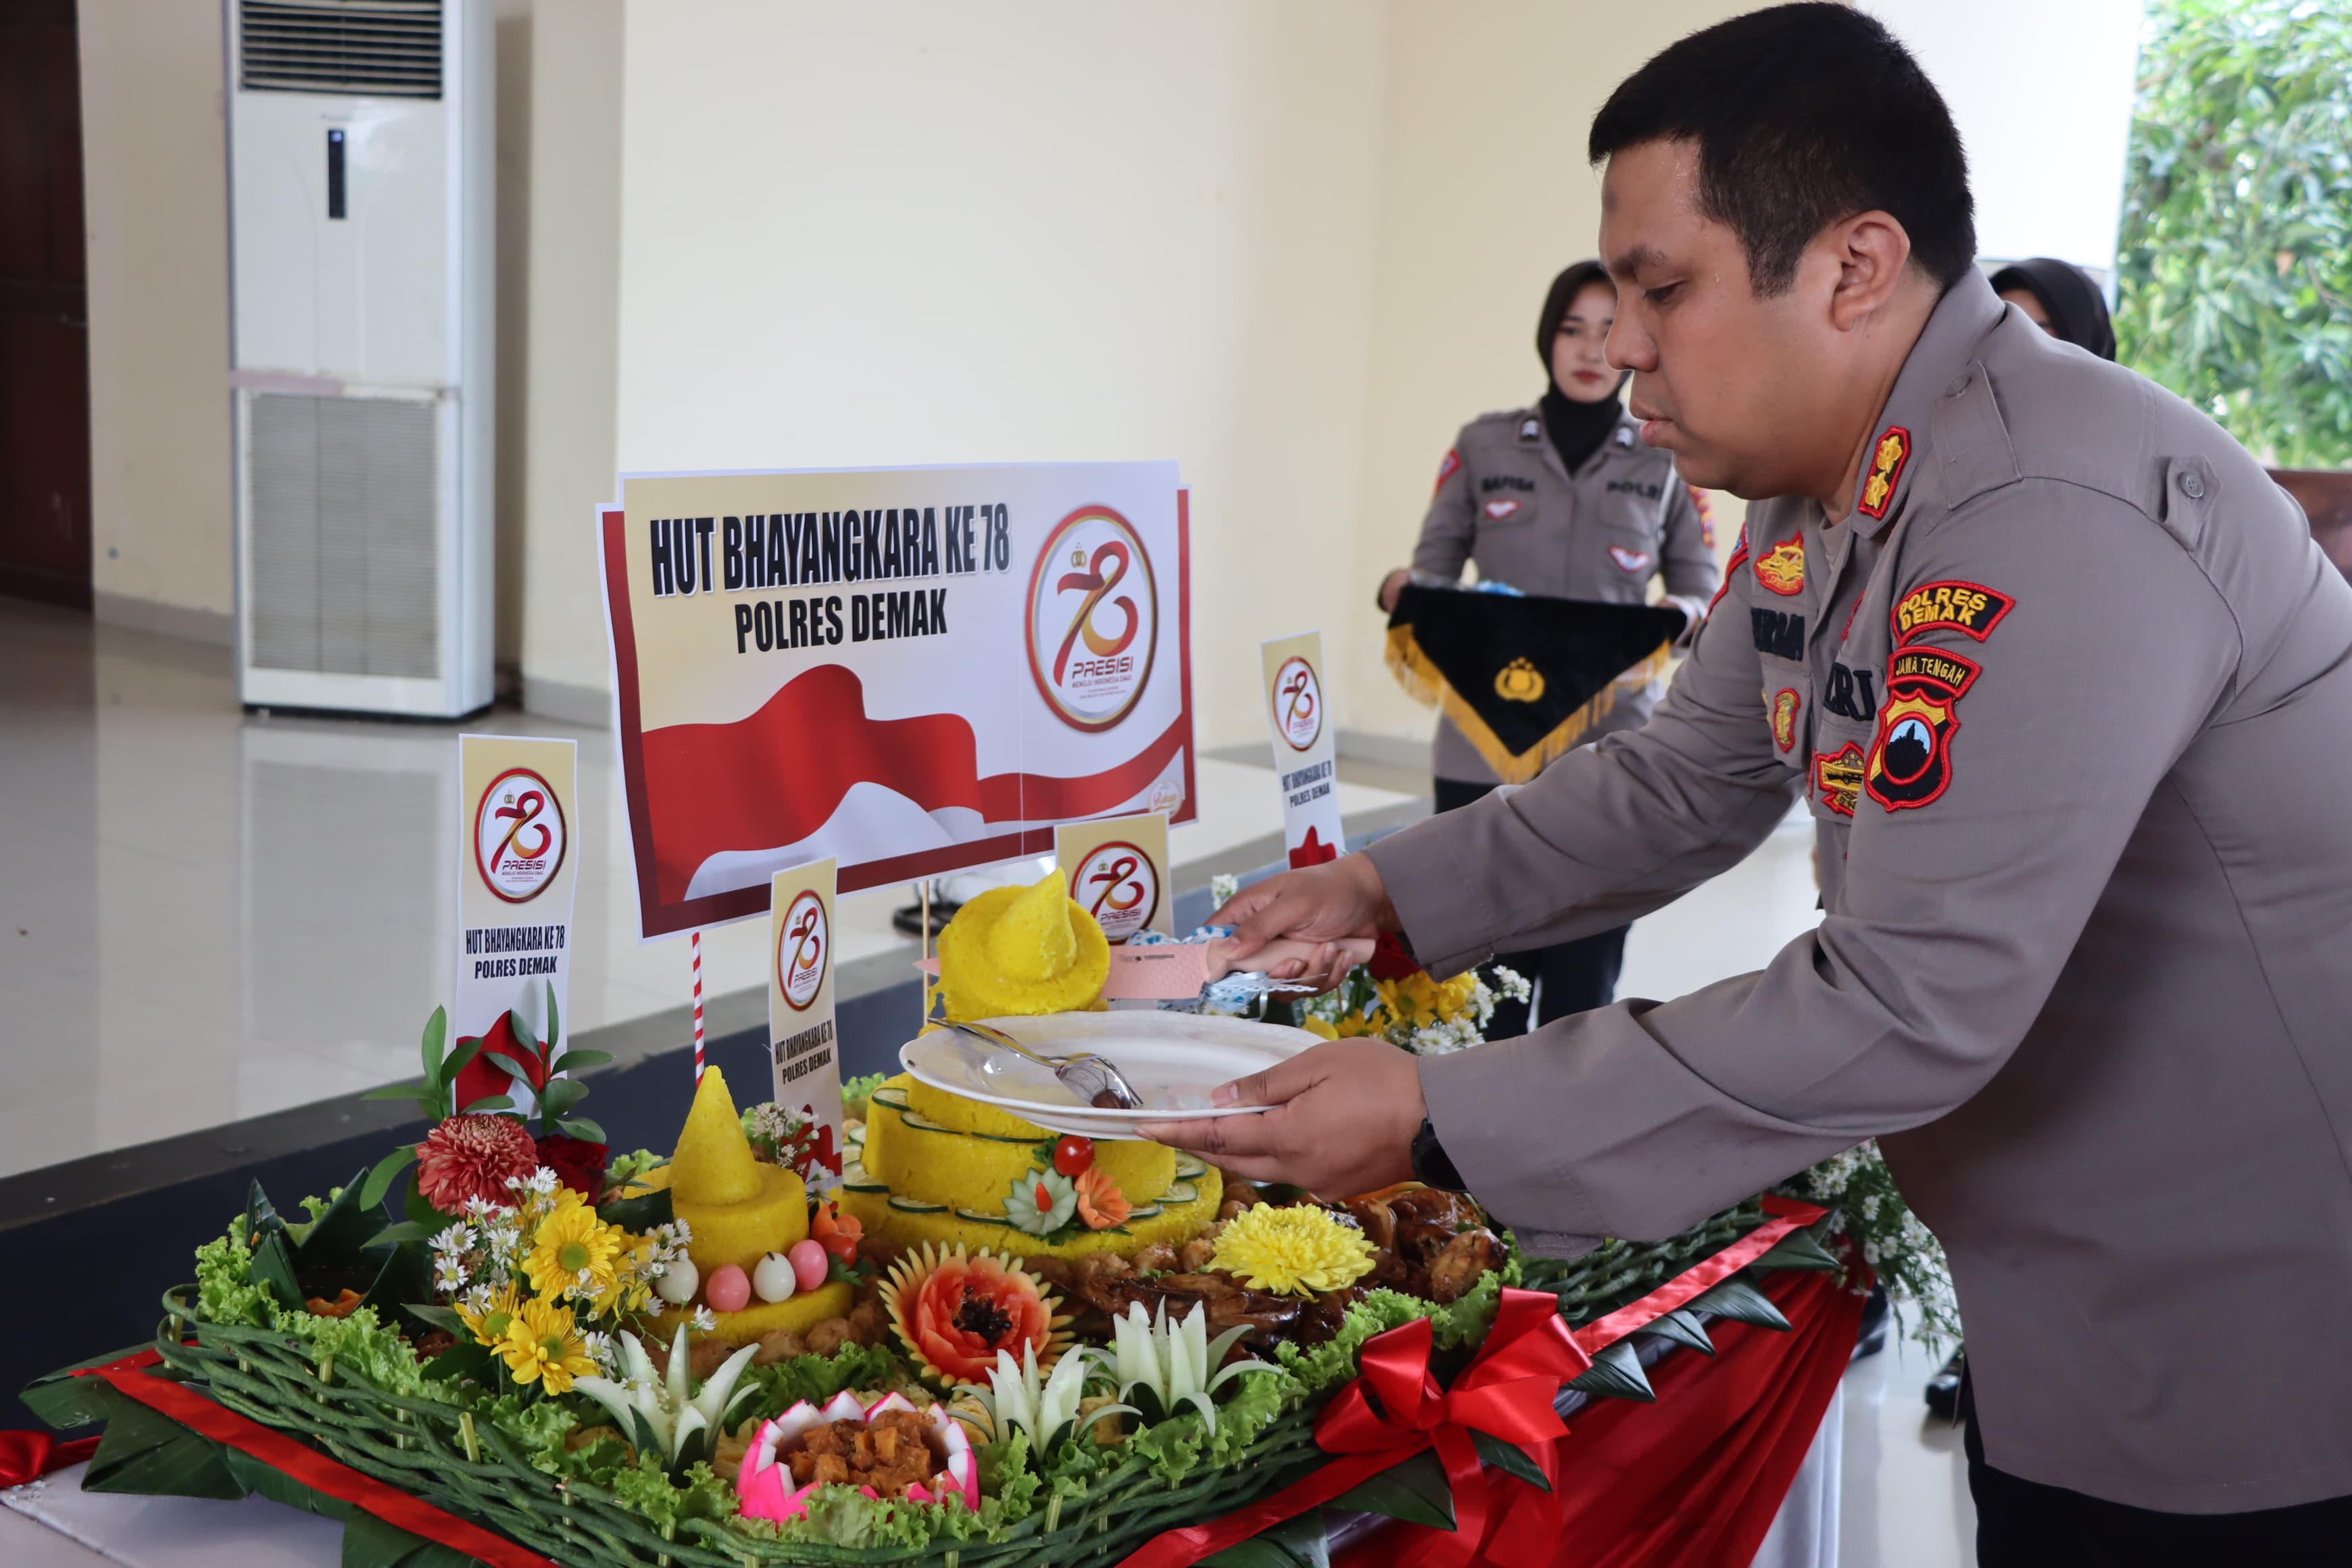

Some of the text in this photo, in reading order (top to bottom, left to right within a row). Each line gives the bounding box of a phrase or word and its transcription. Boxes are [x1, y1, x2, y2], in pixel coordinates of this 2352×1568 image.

[650, 503, 1012, 596] HUT BHAYANGKARA KE 78
[1899, 587, 1988, 618] POLRES
[735, 588, 948, 654] POLRES DEMAK
[1901, 604, 1976, 632] DEMAK
[1072, 656, 1134, 679] PRESISI
[1896, 656, 1965, 687] JAWA TENGAH
[502, 860, 546, 870] PRESISI
[1100, 908, 1142, 921] PRESISI
[466, 925, 565, 954] HUT BHAYANGKARA KE 78
[475, 956, 558, 979] POLRES DEMAK
[775, 1039, 785, 1066] HUT
[786, 1024, 821, 1060] BHAYANGKARA
[820, 1021, 827, 1044] KE
[782, 1047, 832, 1085] POLRES DEMAK
